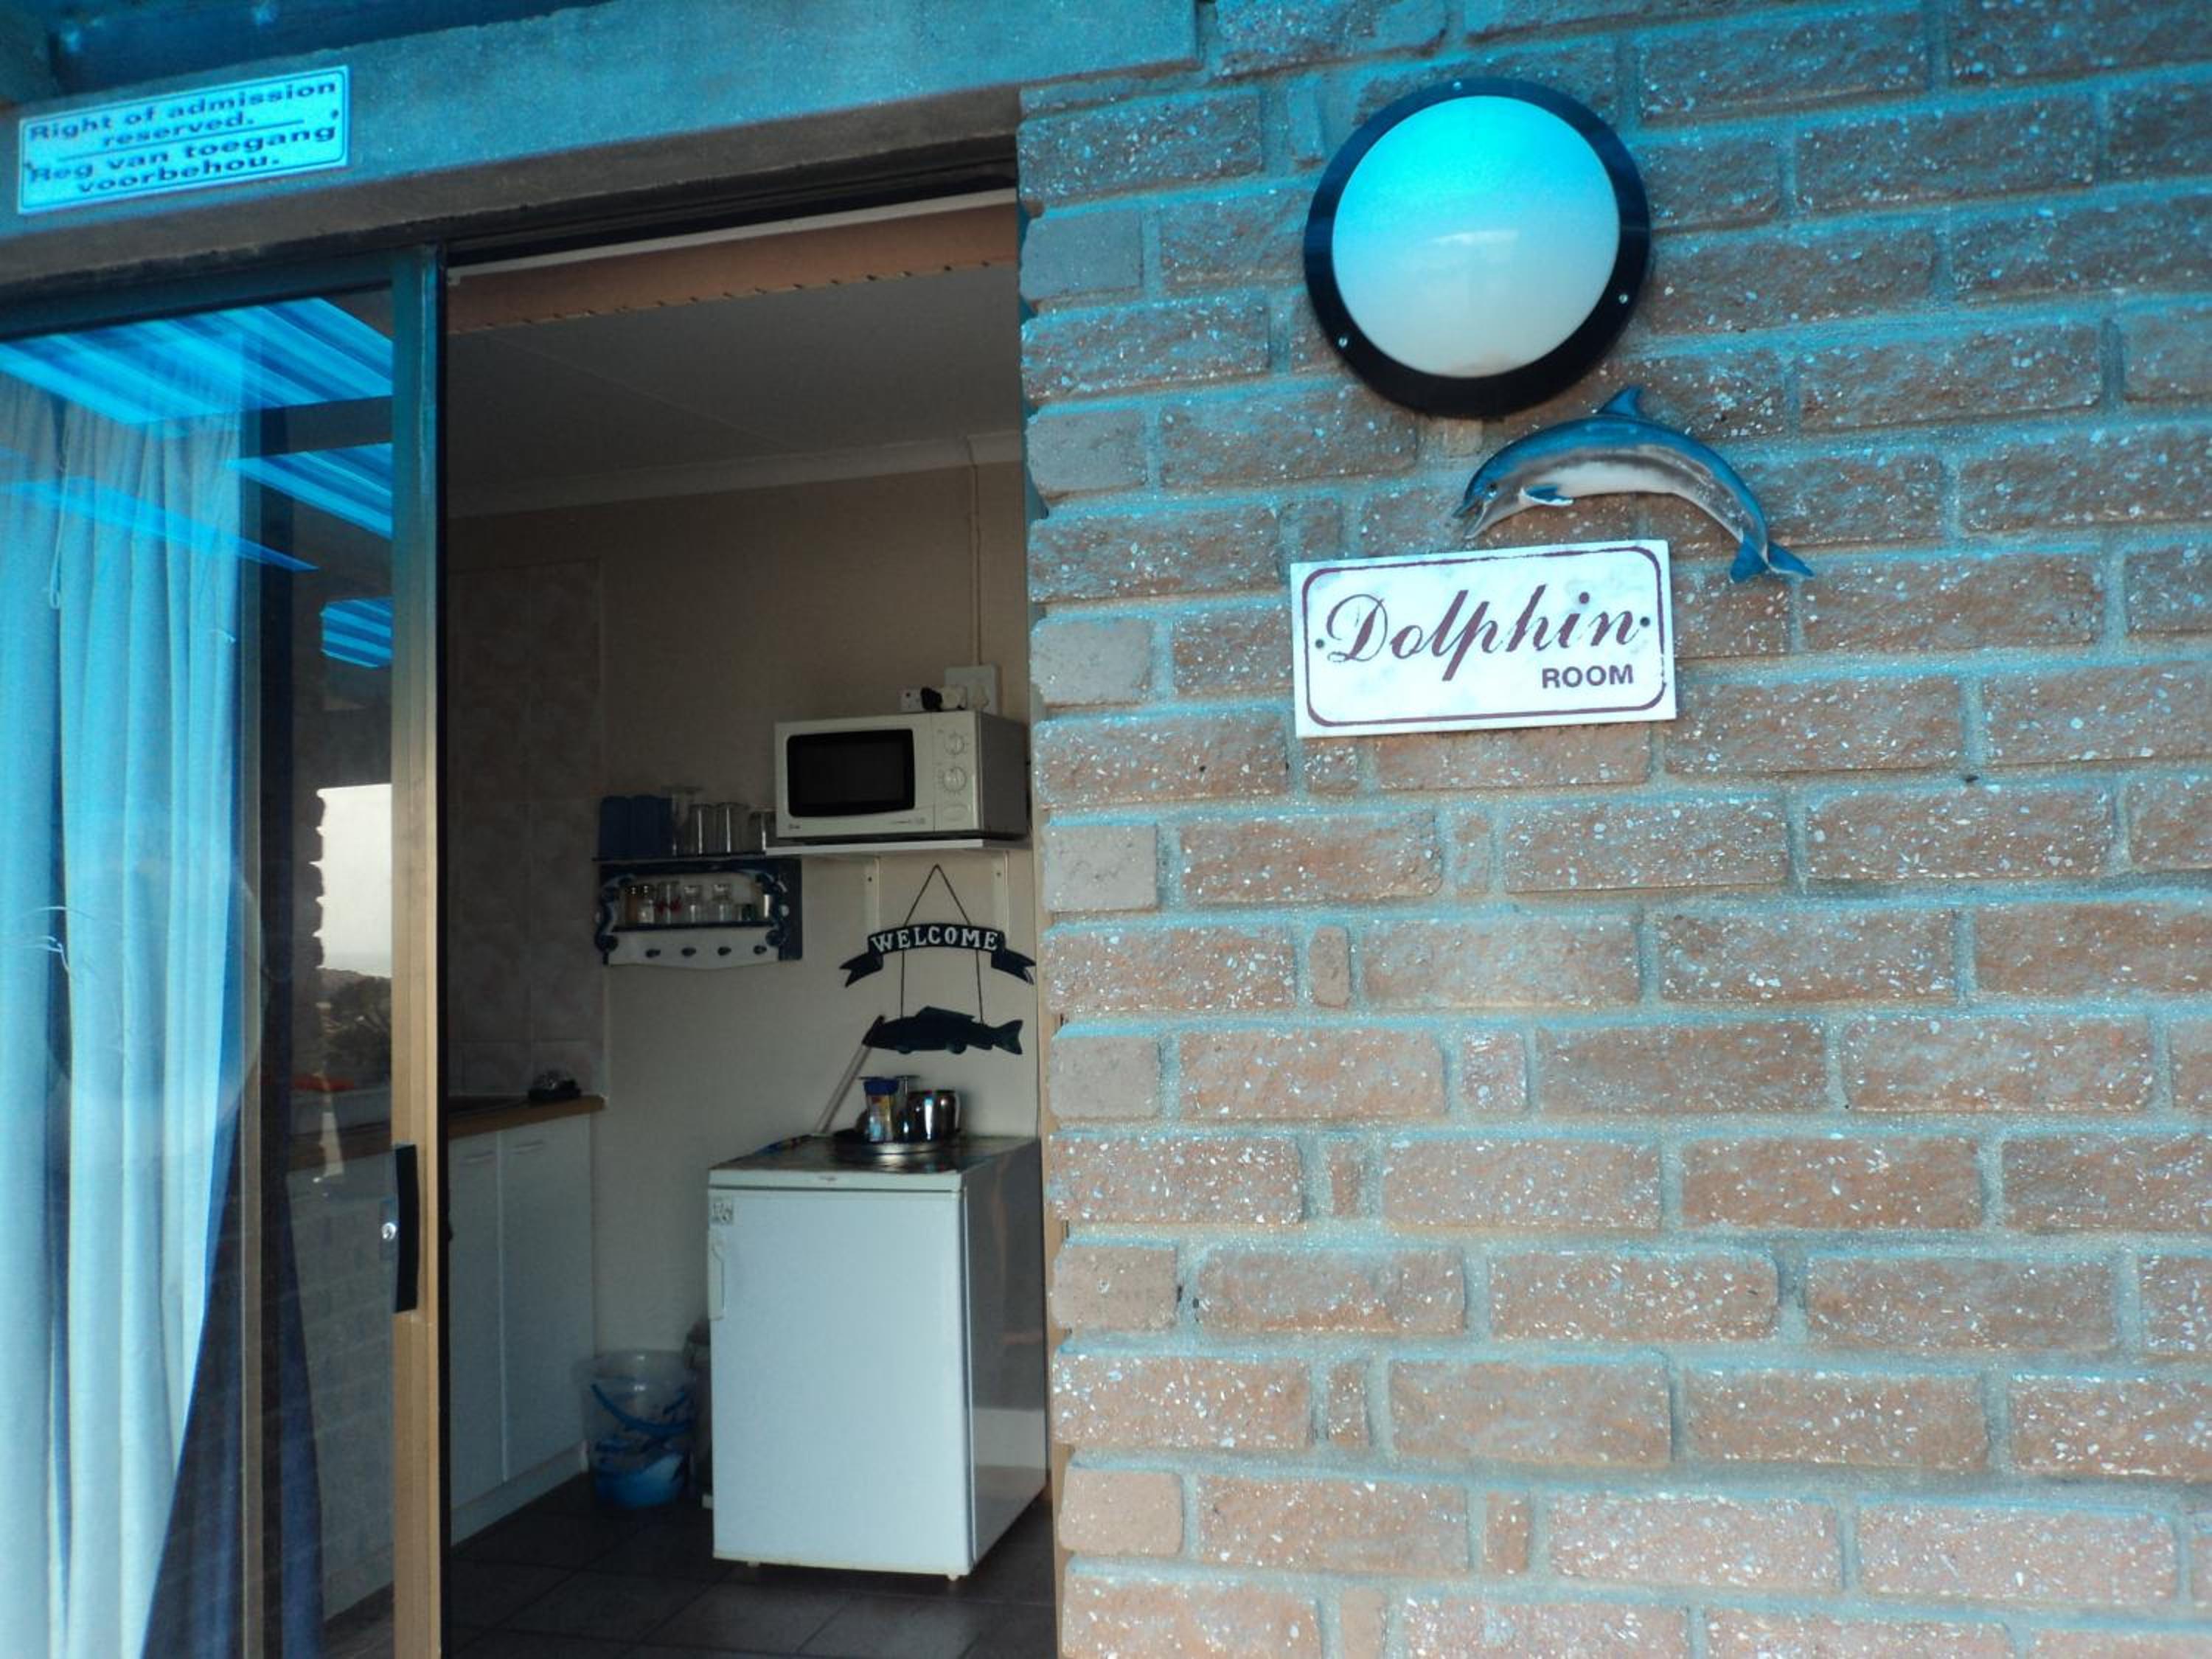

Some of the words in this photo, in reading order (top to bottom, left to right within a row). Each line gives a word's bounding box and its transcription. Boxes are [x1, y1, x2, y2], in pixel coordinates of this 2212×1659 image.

[29, 116, 111, 141] Right
[125, 107, 154, 125] of
[167, 81, 336, 119] admission
[103, 111, 254, 147] reserved.
[29, 163, 94, 182] Reg
[108, 153, 169, 170] van
[184, 124, 336, 158] toegang
[78, 154, 280, 193] voorbehou.
[1327, 585, 1640, 681] Dolphin
[1542, 664, 1634, 689] ROOM
[871, 926, 999, 953] WELCOME
